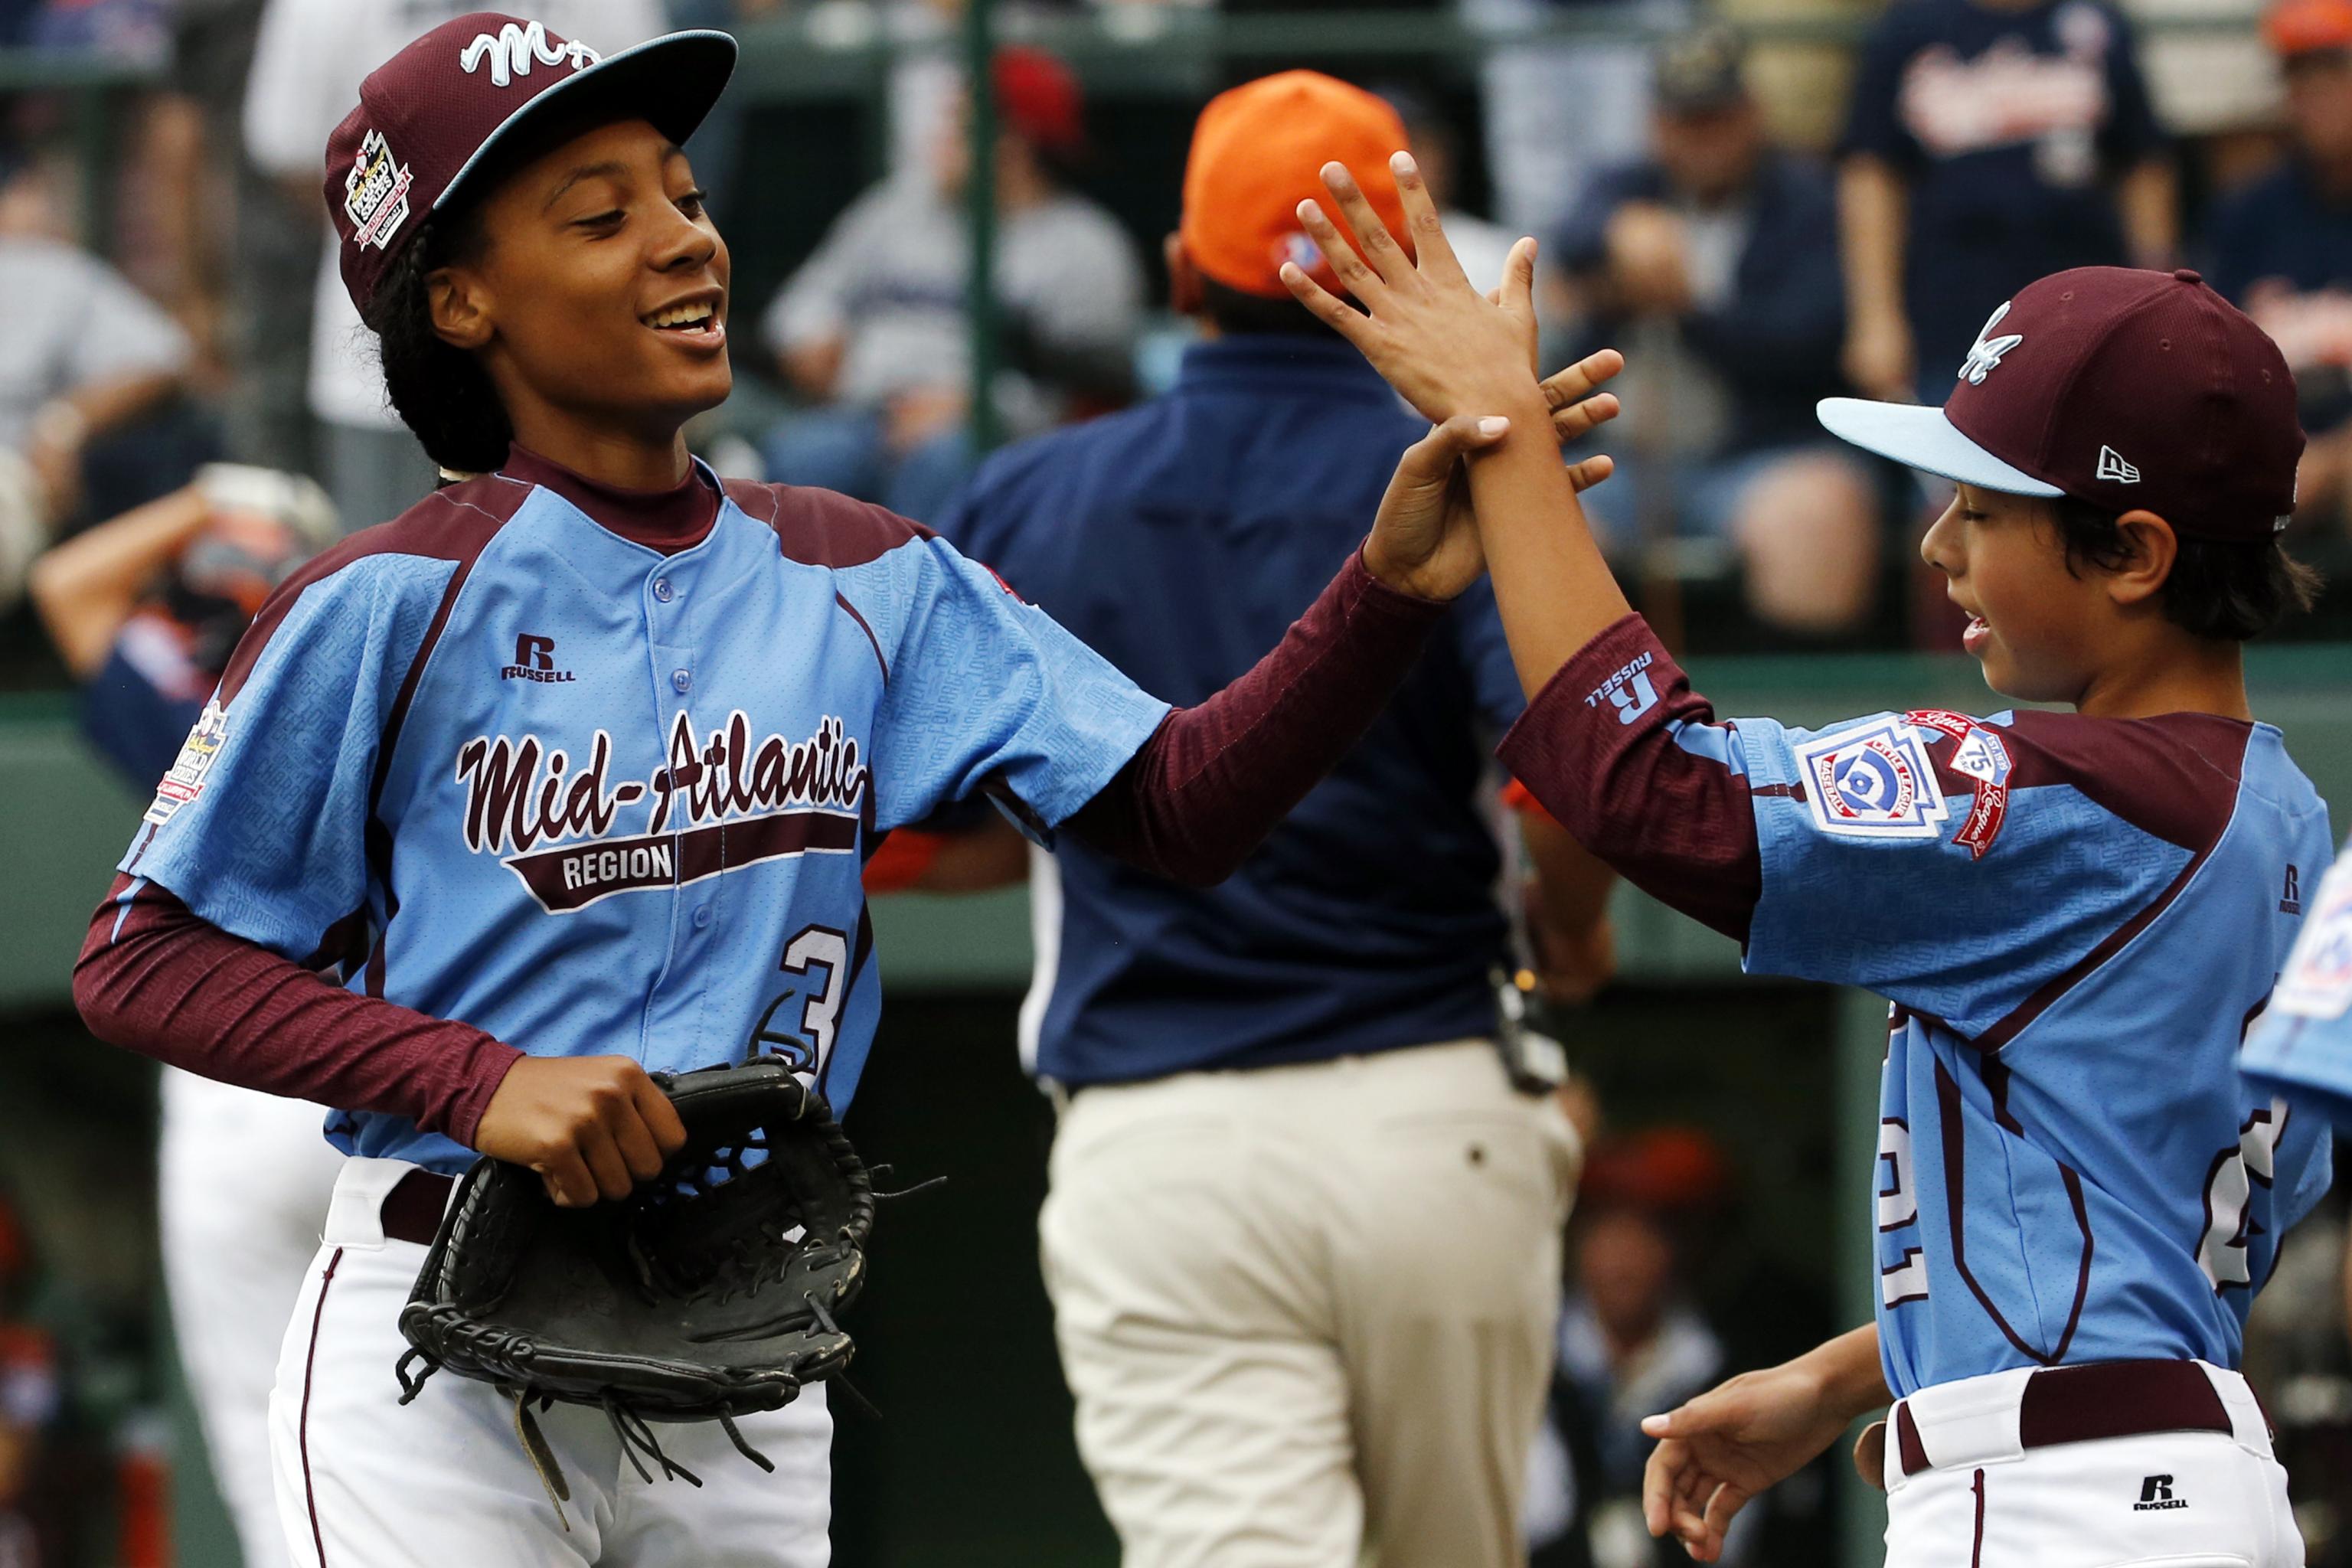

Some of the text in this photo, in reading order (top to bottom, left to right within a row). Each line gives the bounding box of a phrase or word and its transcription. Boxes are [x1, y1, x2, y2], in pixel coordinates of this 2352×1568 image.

[351, 161, 389, 214] WORLD
[361, 175, 393, 221] SERIES
[501, 666, 576, 683] RUSSELL
[515, 632, 555, 670] R
[1584, 651, 1653, 707] RUSSELL
[1609, 669, 1659, 725] R
[1918, 712, 1967, 734] Little
[455, 709, 870, 855] Mid-Atlantic
[1872, 741, 1913, 817] LITTLE LEAGUE
[1965, 743, 1992, 772] 75
[1820, 760, 1845, 814] BASEBALL
[1970, 782, 2003, 841] League
[562, 843, 674, 891] REGION
[779, 923, 848, 1092] 3
[2140, 1474, 2174, 1502] R
